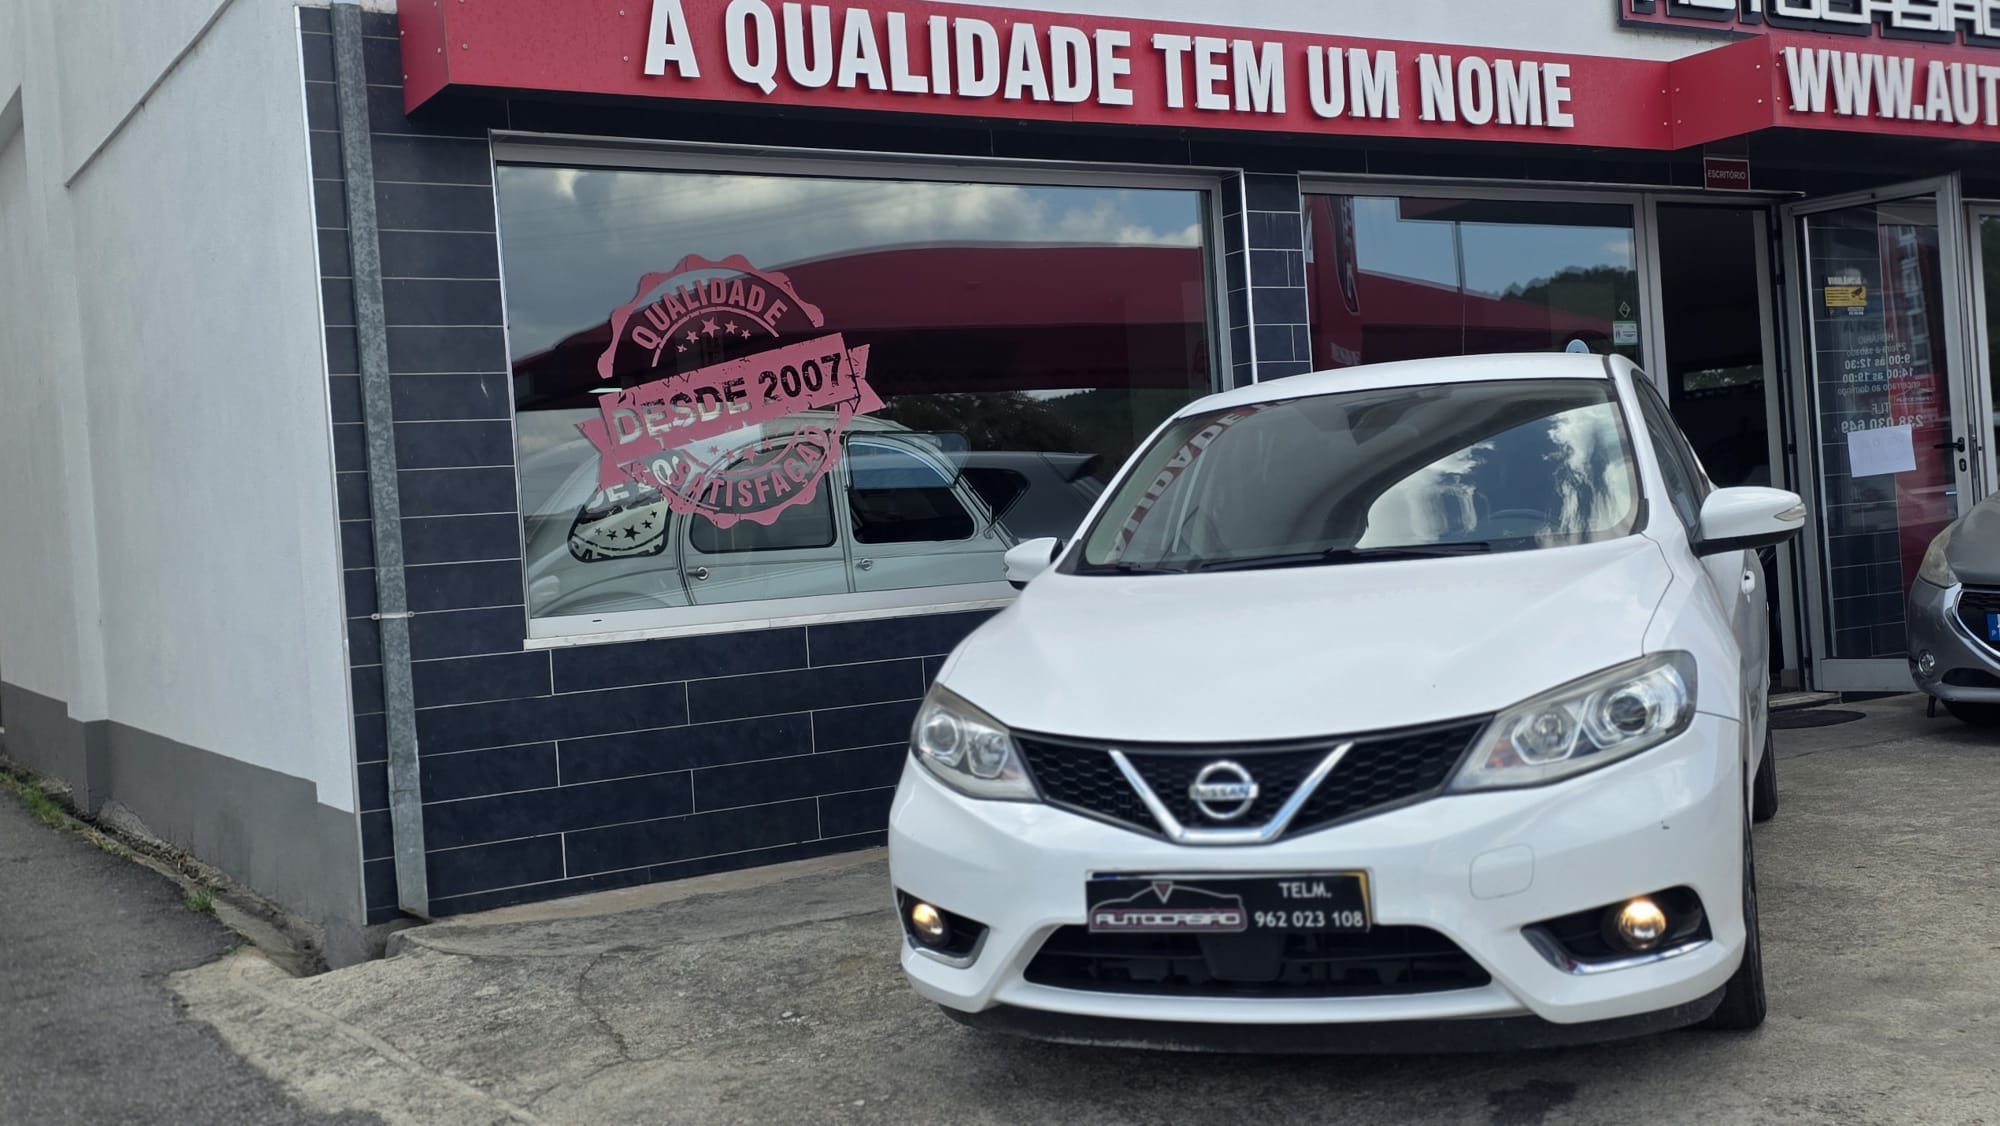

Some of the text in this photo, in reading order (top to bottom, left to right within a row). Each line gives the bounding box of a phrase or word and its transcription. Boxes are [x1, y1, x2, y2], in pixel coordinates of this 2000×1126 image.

[644, 0, 1575, 128] A QUALIDADE TEM UM NOME
[1707, 168, 1746, 180] ESCRITÓRIO
[632, 277, 788, 351] QUALIDADE
[612, 352, 842, 446] DESDE 2007
[1193, 786, 1250, 799] NISSAN
[1278, 881, 1332, 899] TELM.
[1254, 910, 1364, 928] 962 023 108
